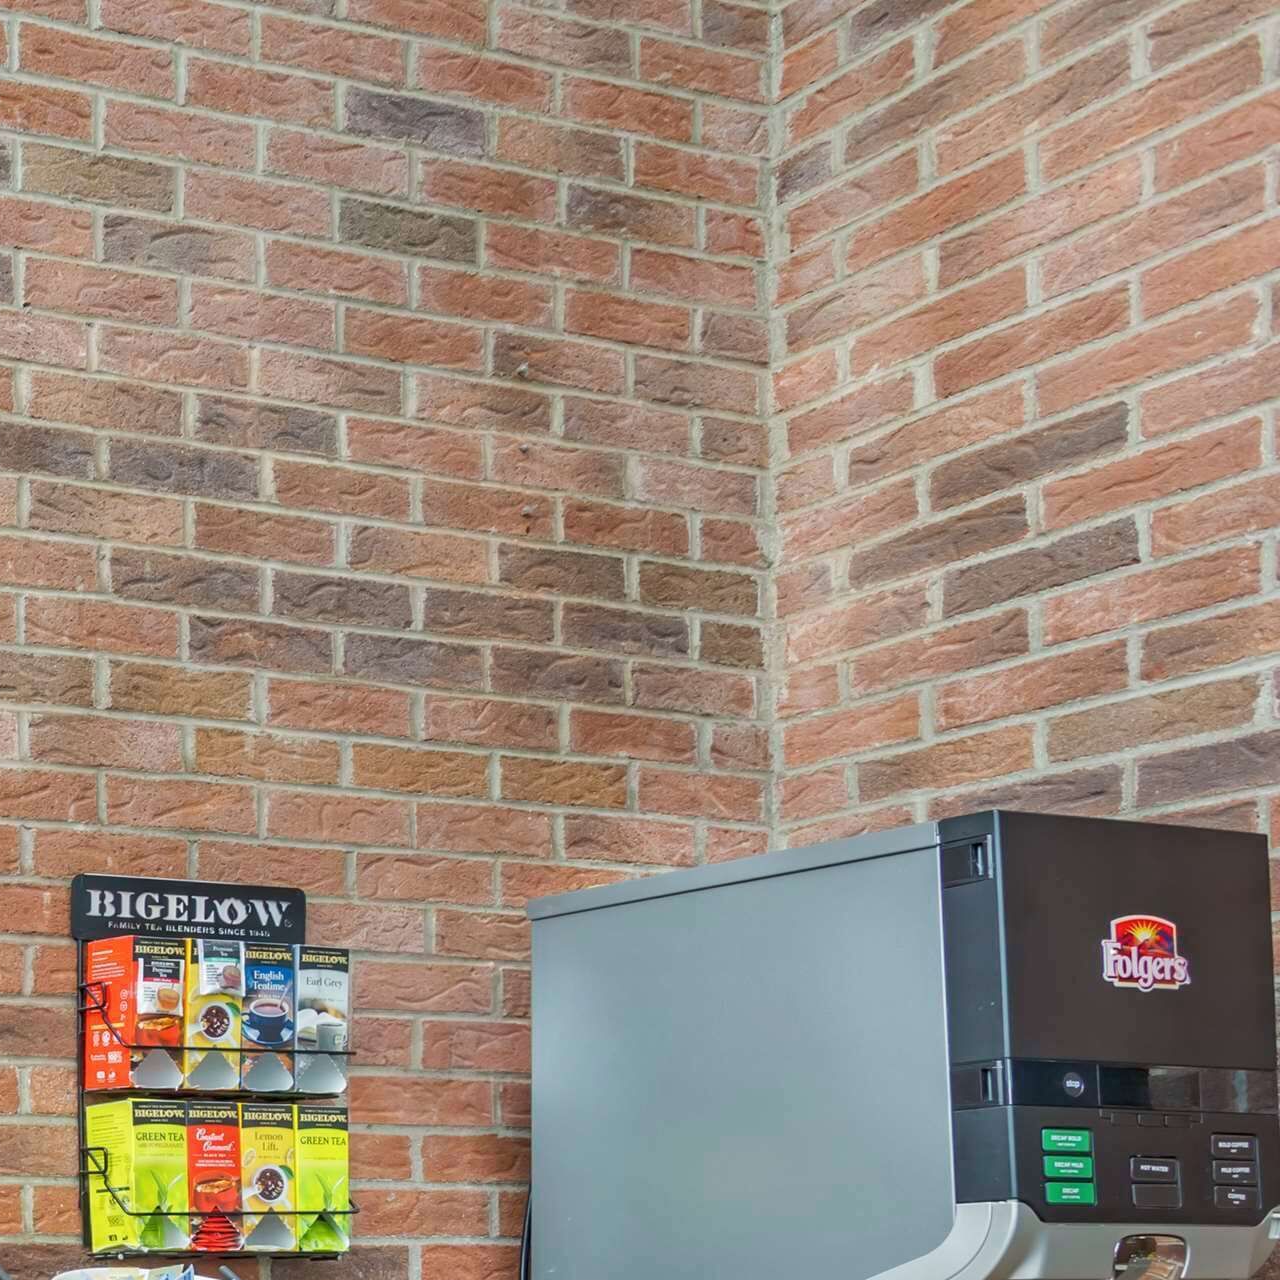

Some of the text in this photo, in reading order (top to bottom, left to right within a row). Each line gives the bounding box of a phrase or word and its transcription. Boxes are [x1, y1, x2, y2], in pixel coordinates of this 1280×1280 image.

[85, 888, 292, 927] BIGELOW
[108, 921, 140, 930] FAMILY
[145, 923, 163, 931] TEA
[166, 925, 215, 935] BLENDERS
[218, 928, 246, 936] SINCE
[134, 945, 185, 956] BIGELOW
[245, 950, 293, 962] BIGELOW
[301, 953, 348, 965] BIGELOW
[1102, 940, 1187, 987] Folgers
[253, 970, 285, 983] English
[306, 976, 343, 990] Earl Grey
[134, 1109, 185, 1118] BIGELOW
[189, 1109, 238, 1119] BIGELOW
[243, 1111, 292, 1122] BIGELOW
[300, 1113, 347, 1123] BIGELOW
[135, 1131, 185, 1142] GREEN TEA
[254, 1131, 284, 1142] Lemon
[300, 1136, 347, 1146] GREEN TEA
